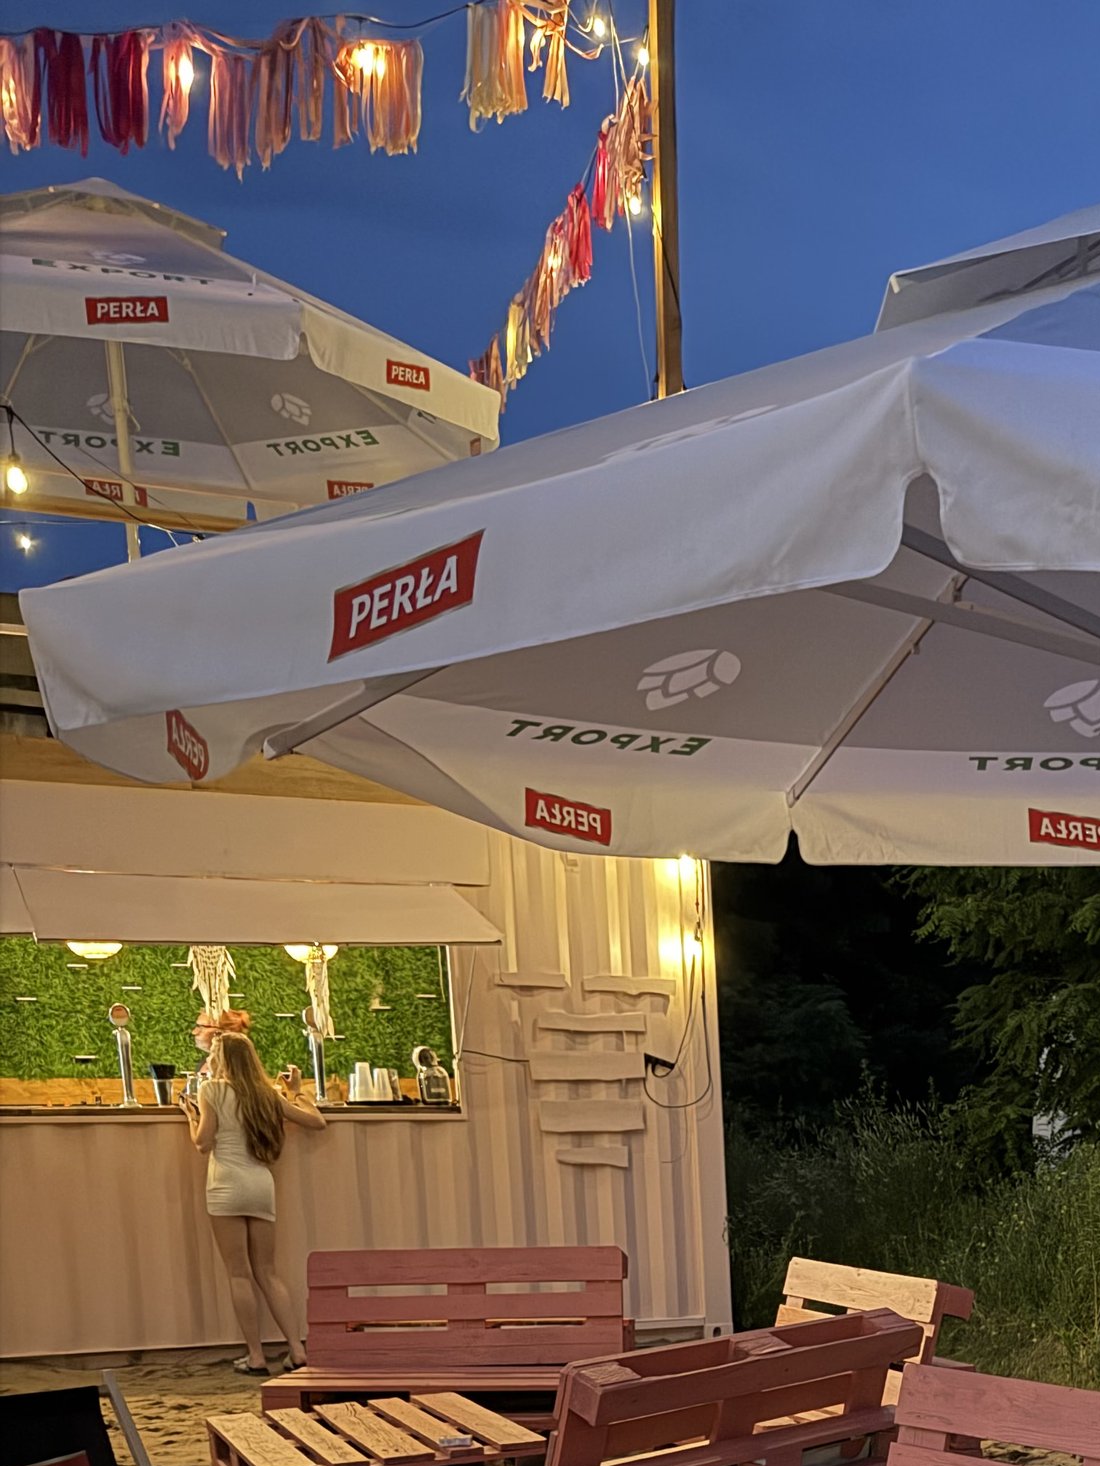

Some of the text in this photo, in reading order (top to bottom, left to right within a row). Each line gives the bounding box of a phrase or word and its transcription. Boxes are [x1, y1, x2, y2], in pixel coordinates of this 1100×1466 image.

[31, 257, 214, 285] EXPORT
[96, 301, 160, 319] PERŁA
[391, 365, 425, 385] PERŁA
[349, 554, 459, 639] PERŁA
